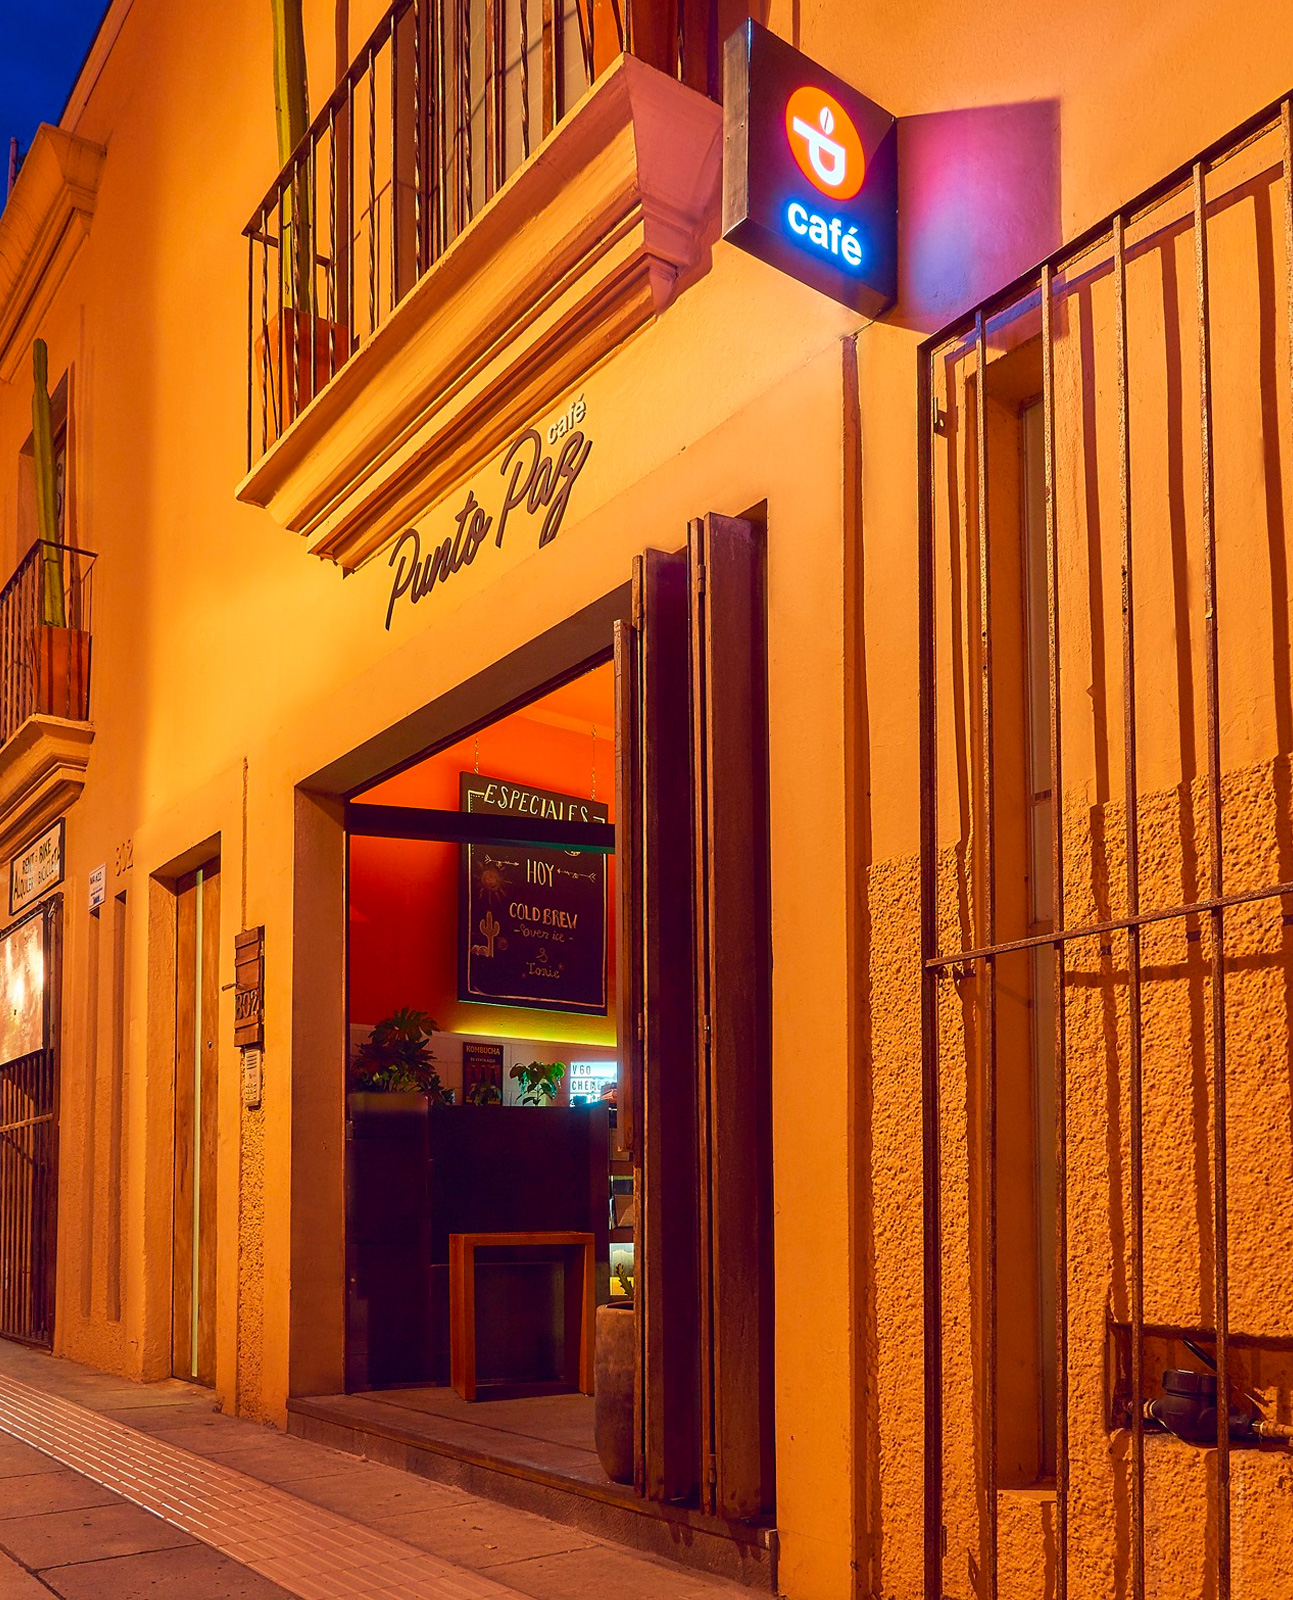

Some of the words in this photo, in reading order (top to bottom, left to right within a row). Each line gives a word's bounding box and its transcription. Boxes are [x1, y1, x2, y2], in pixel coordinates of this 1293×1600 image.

[788, 202, 862, 266] café
[547, 393, 586, 445] café
[385, 490, 493, 631] Punto
[495, 428, 593, 549] Paz
[39, 838, 51, 864] BIKE
[526, 858, 555, 887] HOY
[509, 902, 541, 921] COLD
[542, 908, 578, 929] BREW
[466, 1045, 500, 1055] KOMBUCHA
